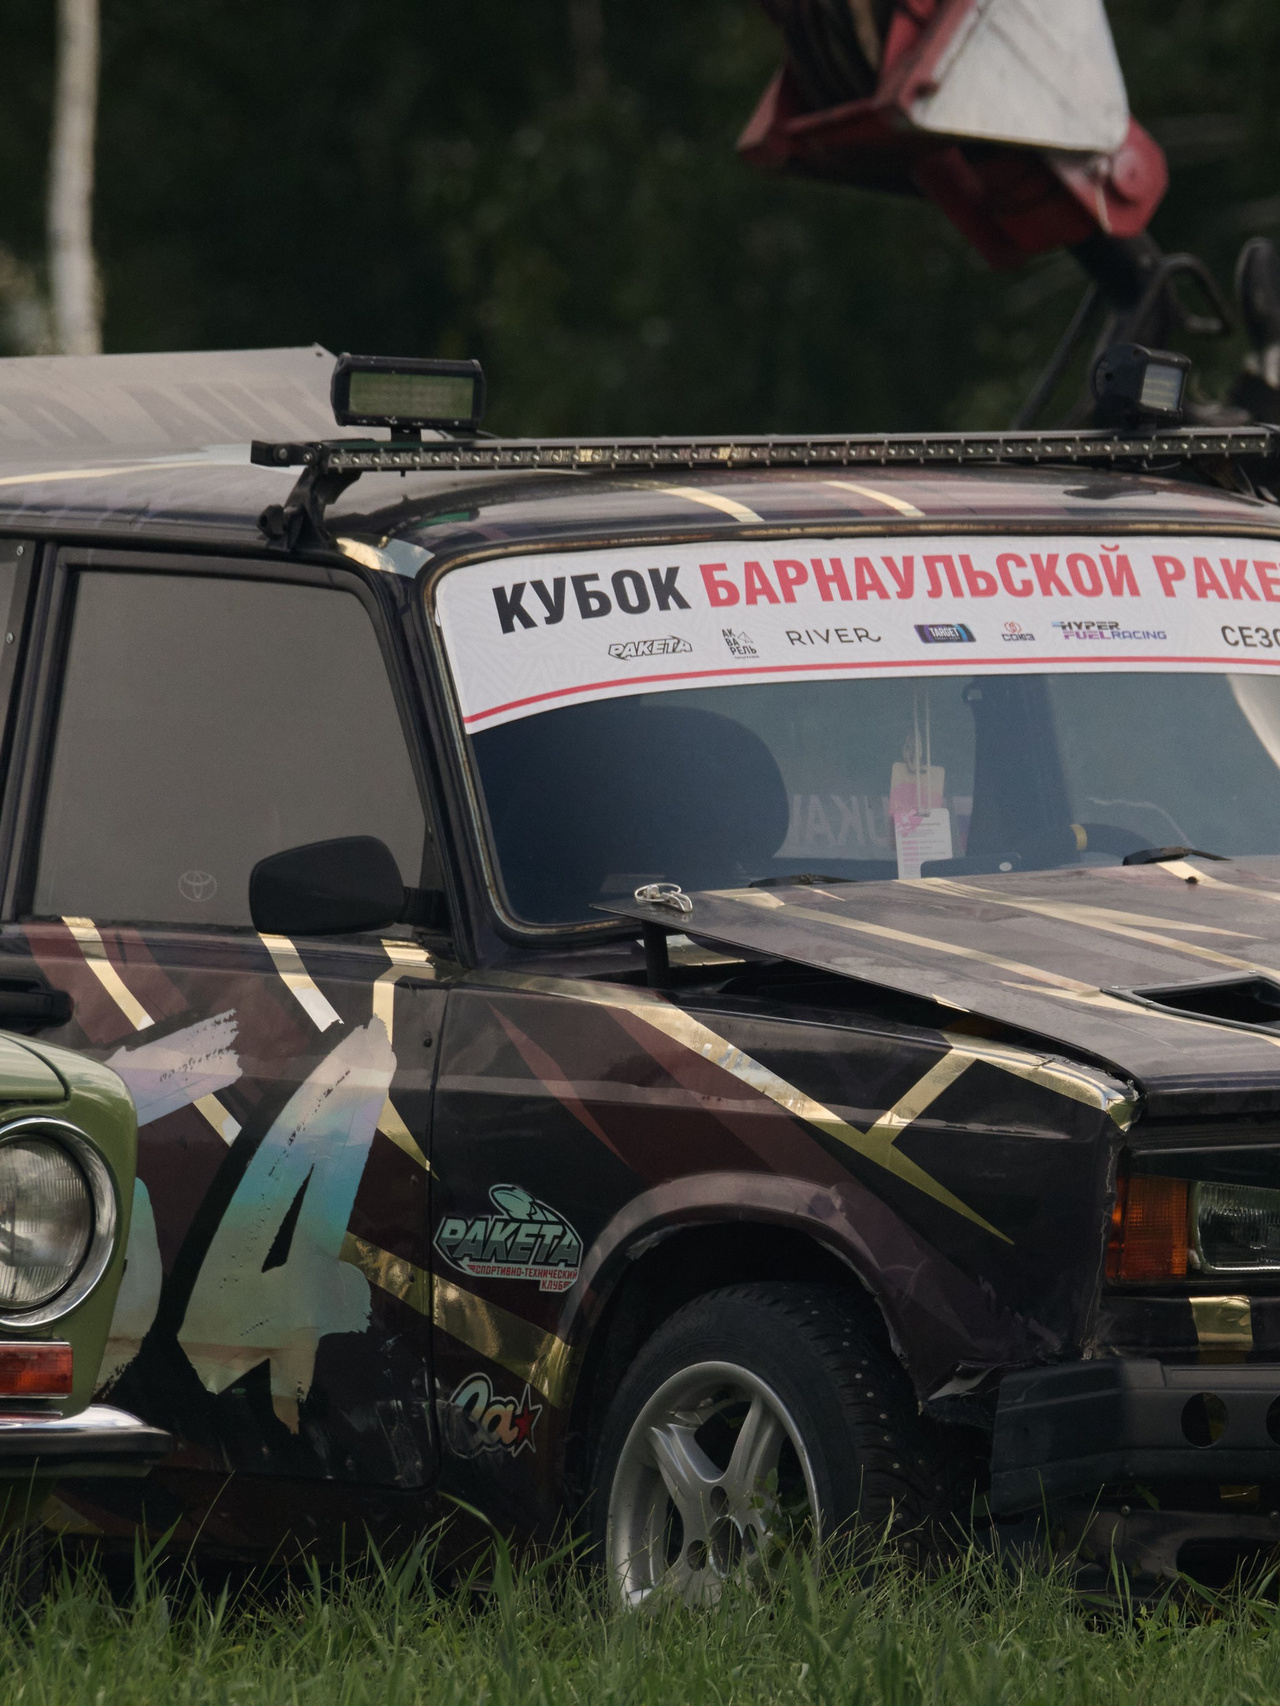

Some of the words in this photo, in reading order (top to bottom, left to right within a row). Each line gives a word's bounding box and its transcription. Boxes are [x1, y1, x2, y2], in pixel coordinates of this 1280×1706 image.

[492, 566, 692, 635] КУБОК
[699, 544, 1141, 608] БАРНАУЛЬСКОЙ
[928, 627, 960, 638] TARGET
[1058, 621, 1120, 631] HYPER
[786, 626, 881, 647] RIVER
[441, 1218, 579, 1266] РАКЕТА
[475, 1265, 578, 1279] СПОРТИВНО-ТЕХНИЧЕСКИЙ
[541, 1280, 563, 1290] КЛУБ
